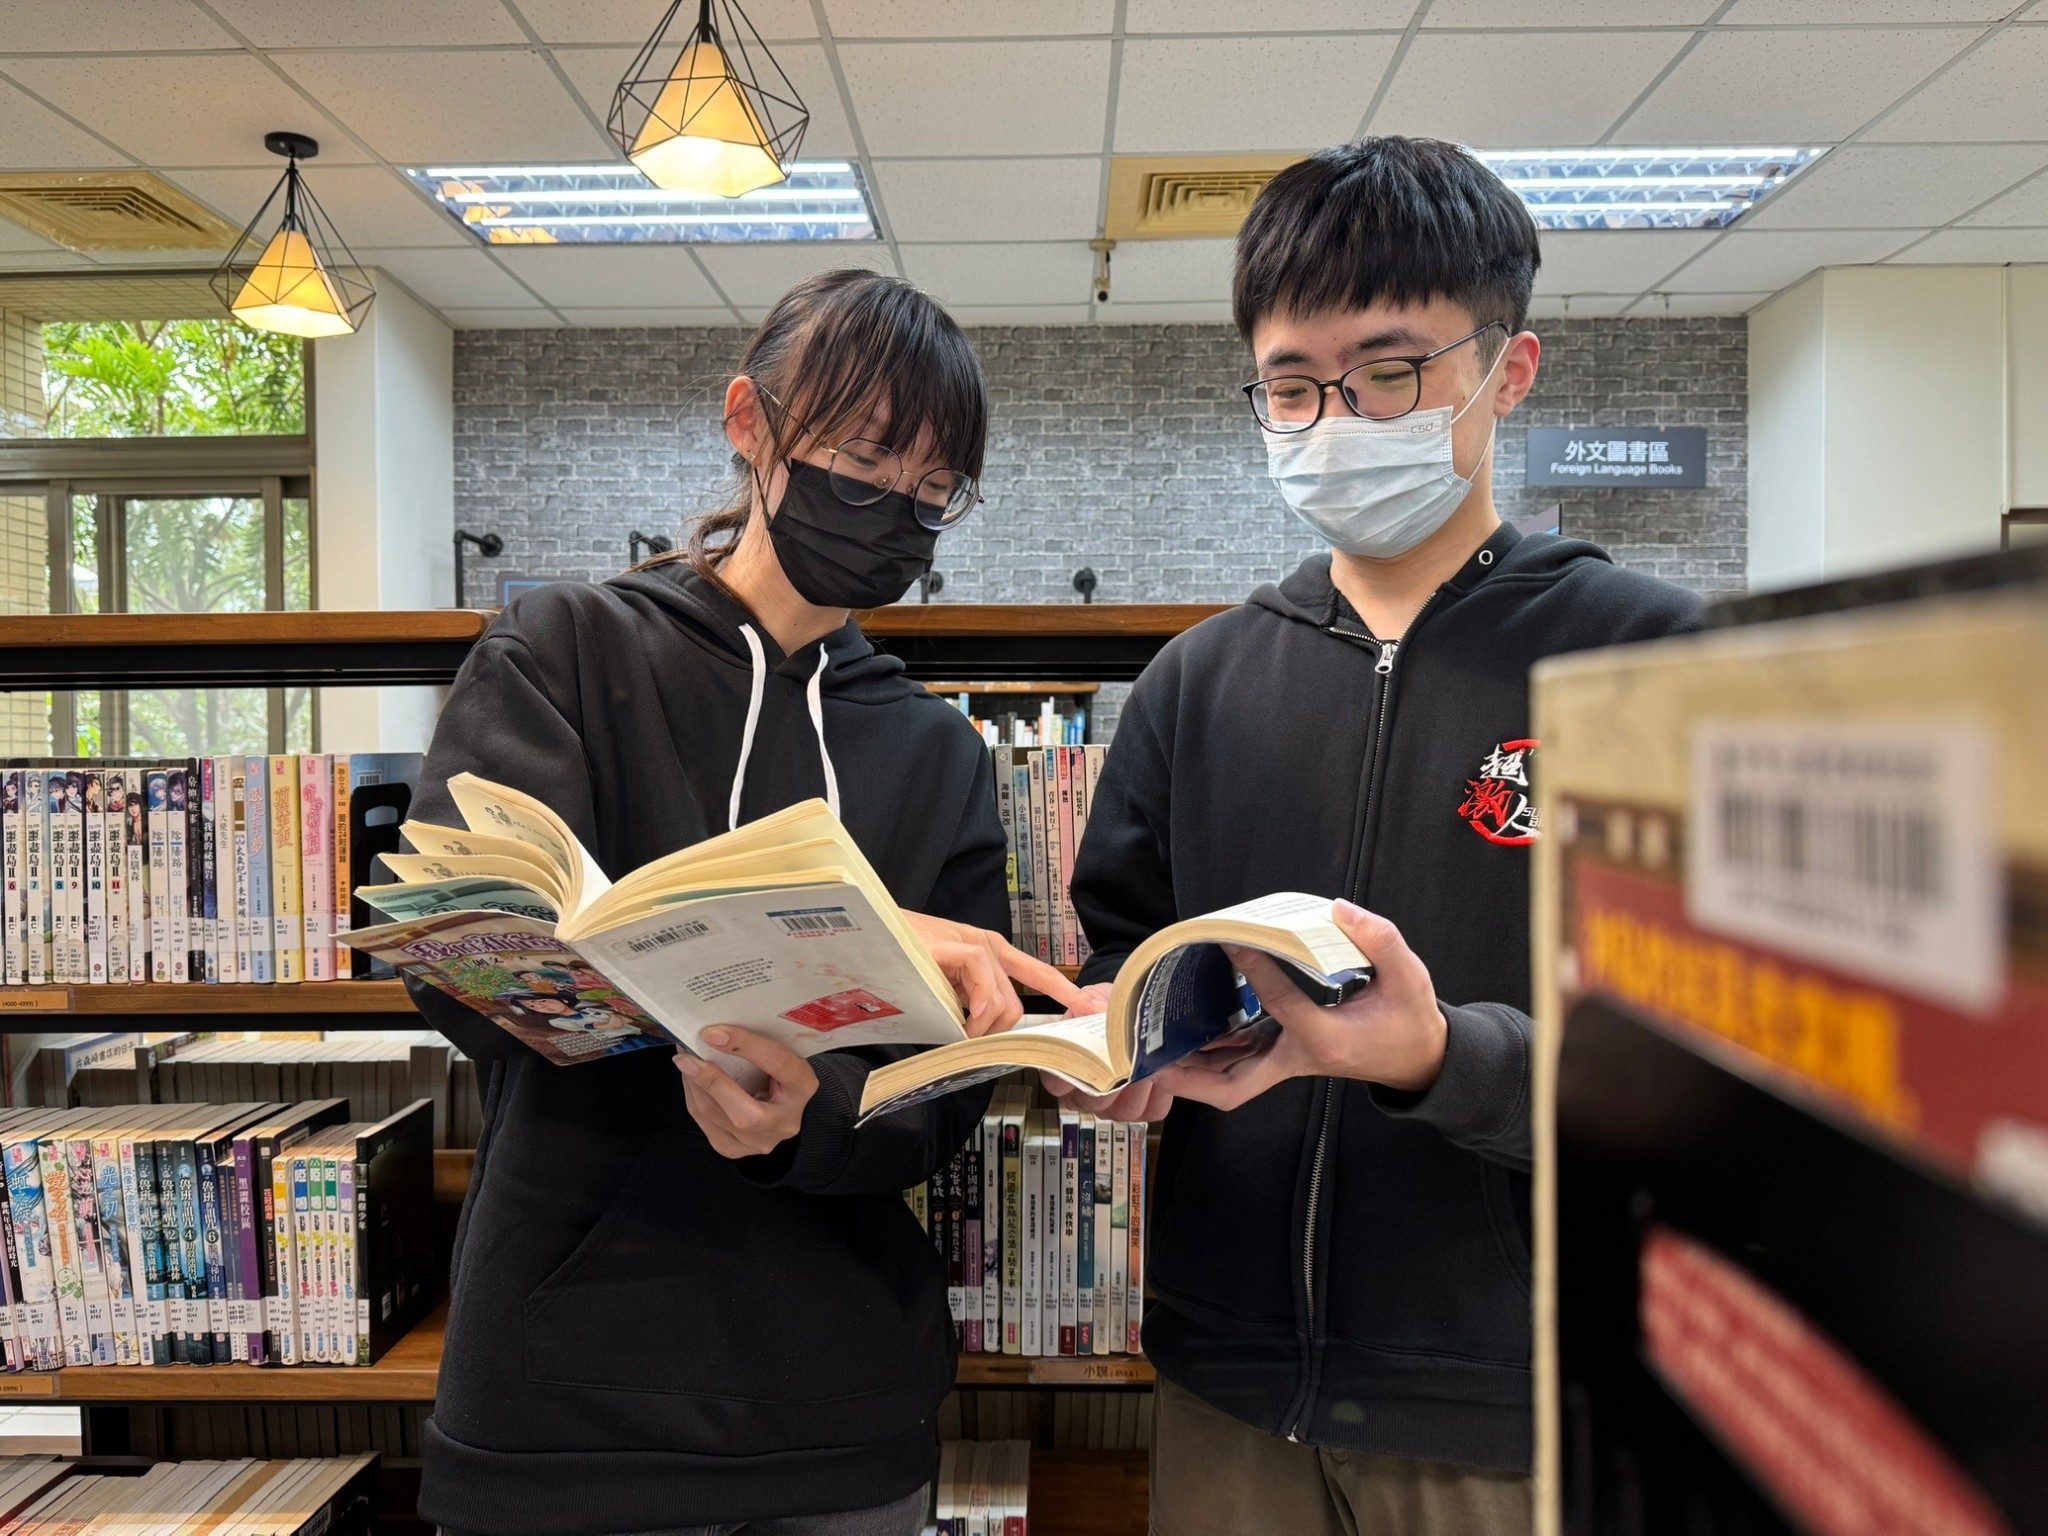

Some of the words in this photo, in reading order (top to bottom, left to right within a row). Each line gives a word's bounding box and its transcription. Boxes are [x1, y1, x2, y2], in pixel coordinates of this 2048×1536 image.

[1564, 440, 1670, 462] 外文圖書區
[1550, 462, 1592, 476] Foreign
[1593, 463, 1648, 476] Language
[1648, 463, 1684, 476] Books
